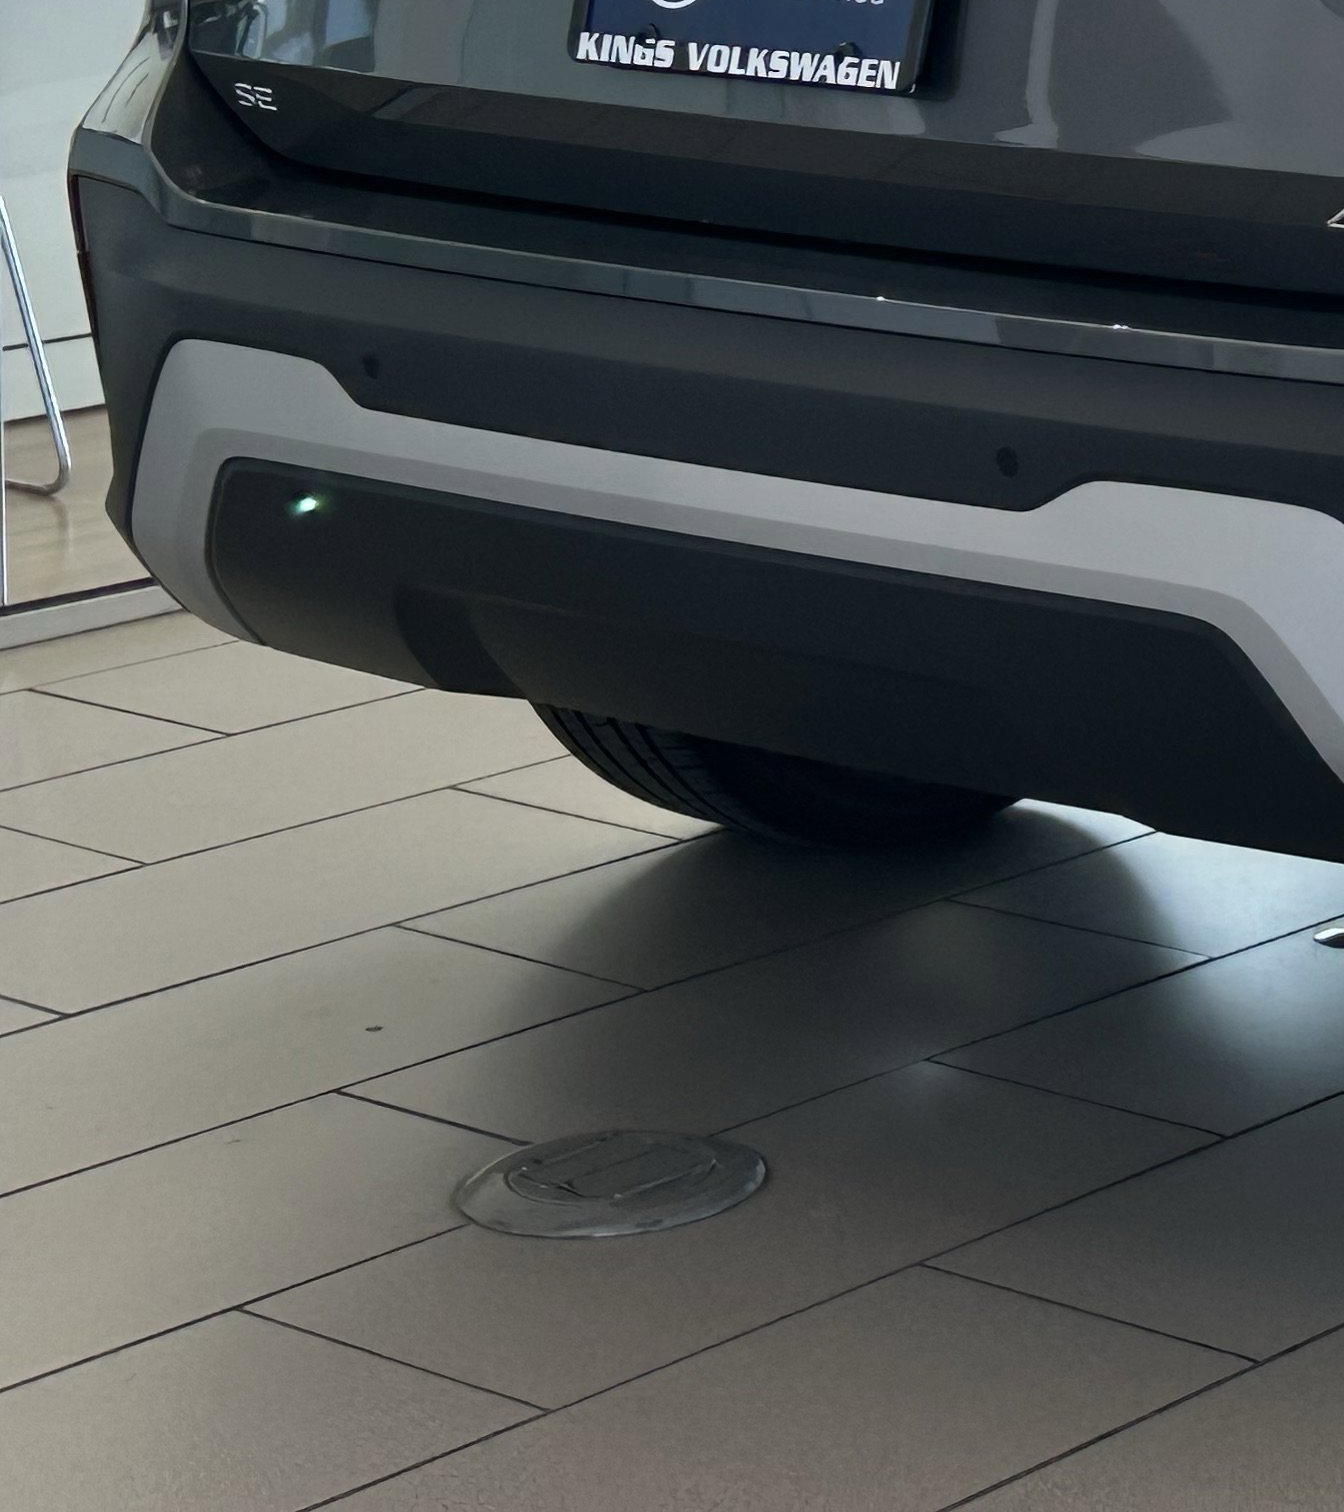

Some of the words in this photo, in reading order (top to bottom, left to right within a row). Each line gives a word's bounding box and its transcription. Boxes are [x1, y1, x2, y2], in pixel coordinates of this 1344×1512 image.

[575, 31, 676, 69] KINGS
[687, 43, 902, 90] VOLKSWAGEN
[234, 82, 278, 110] SE
